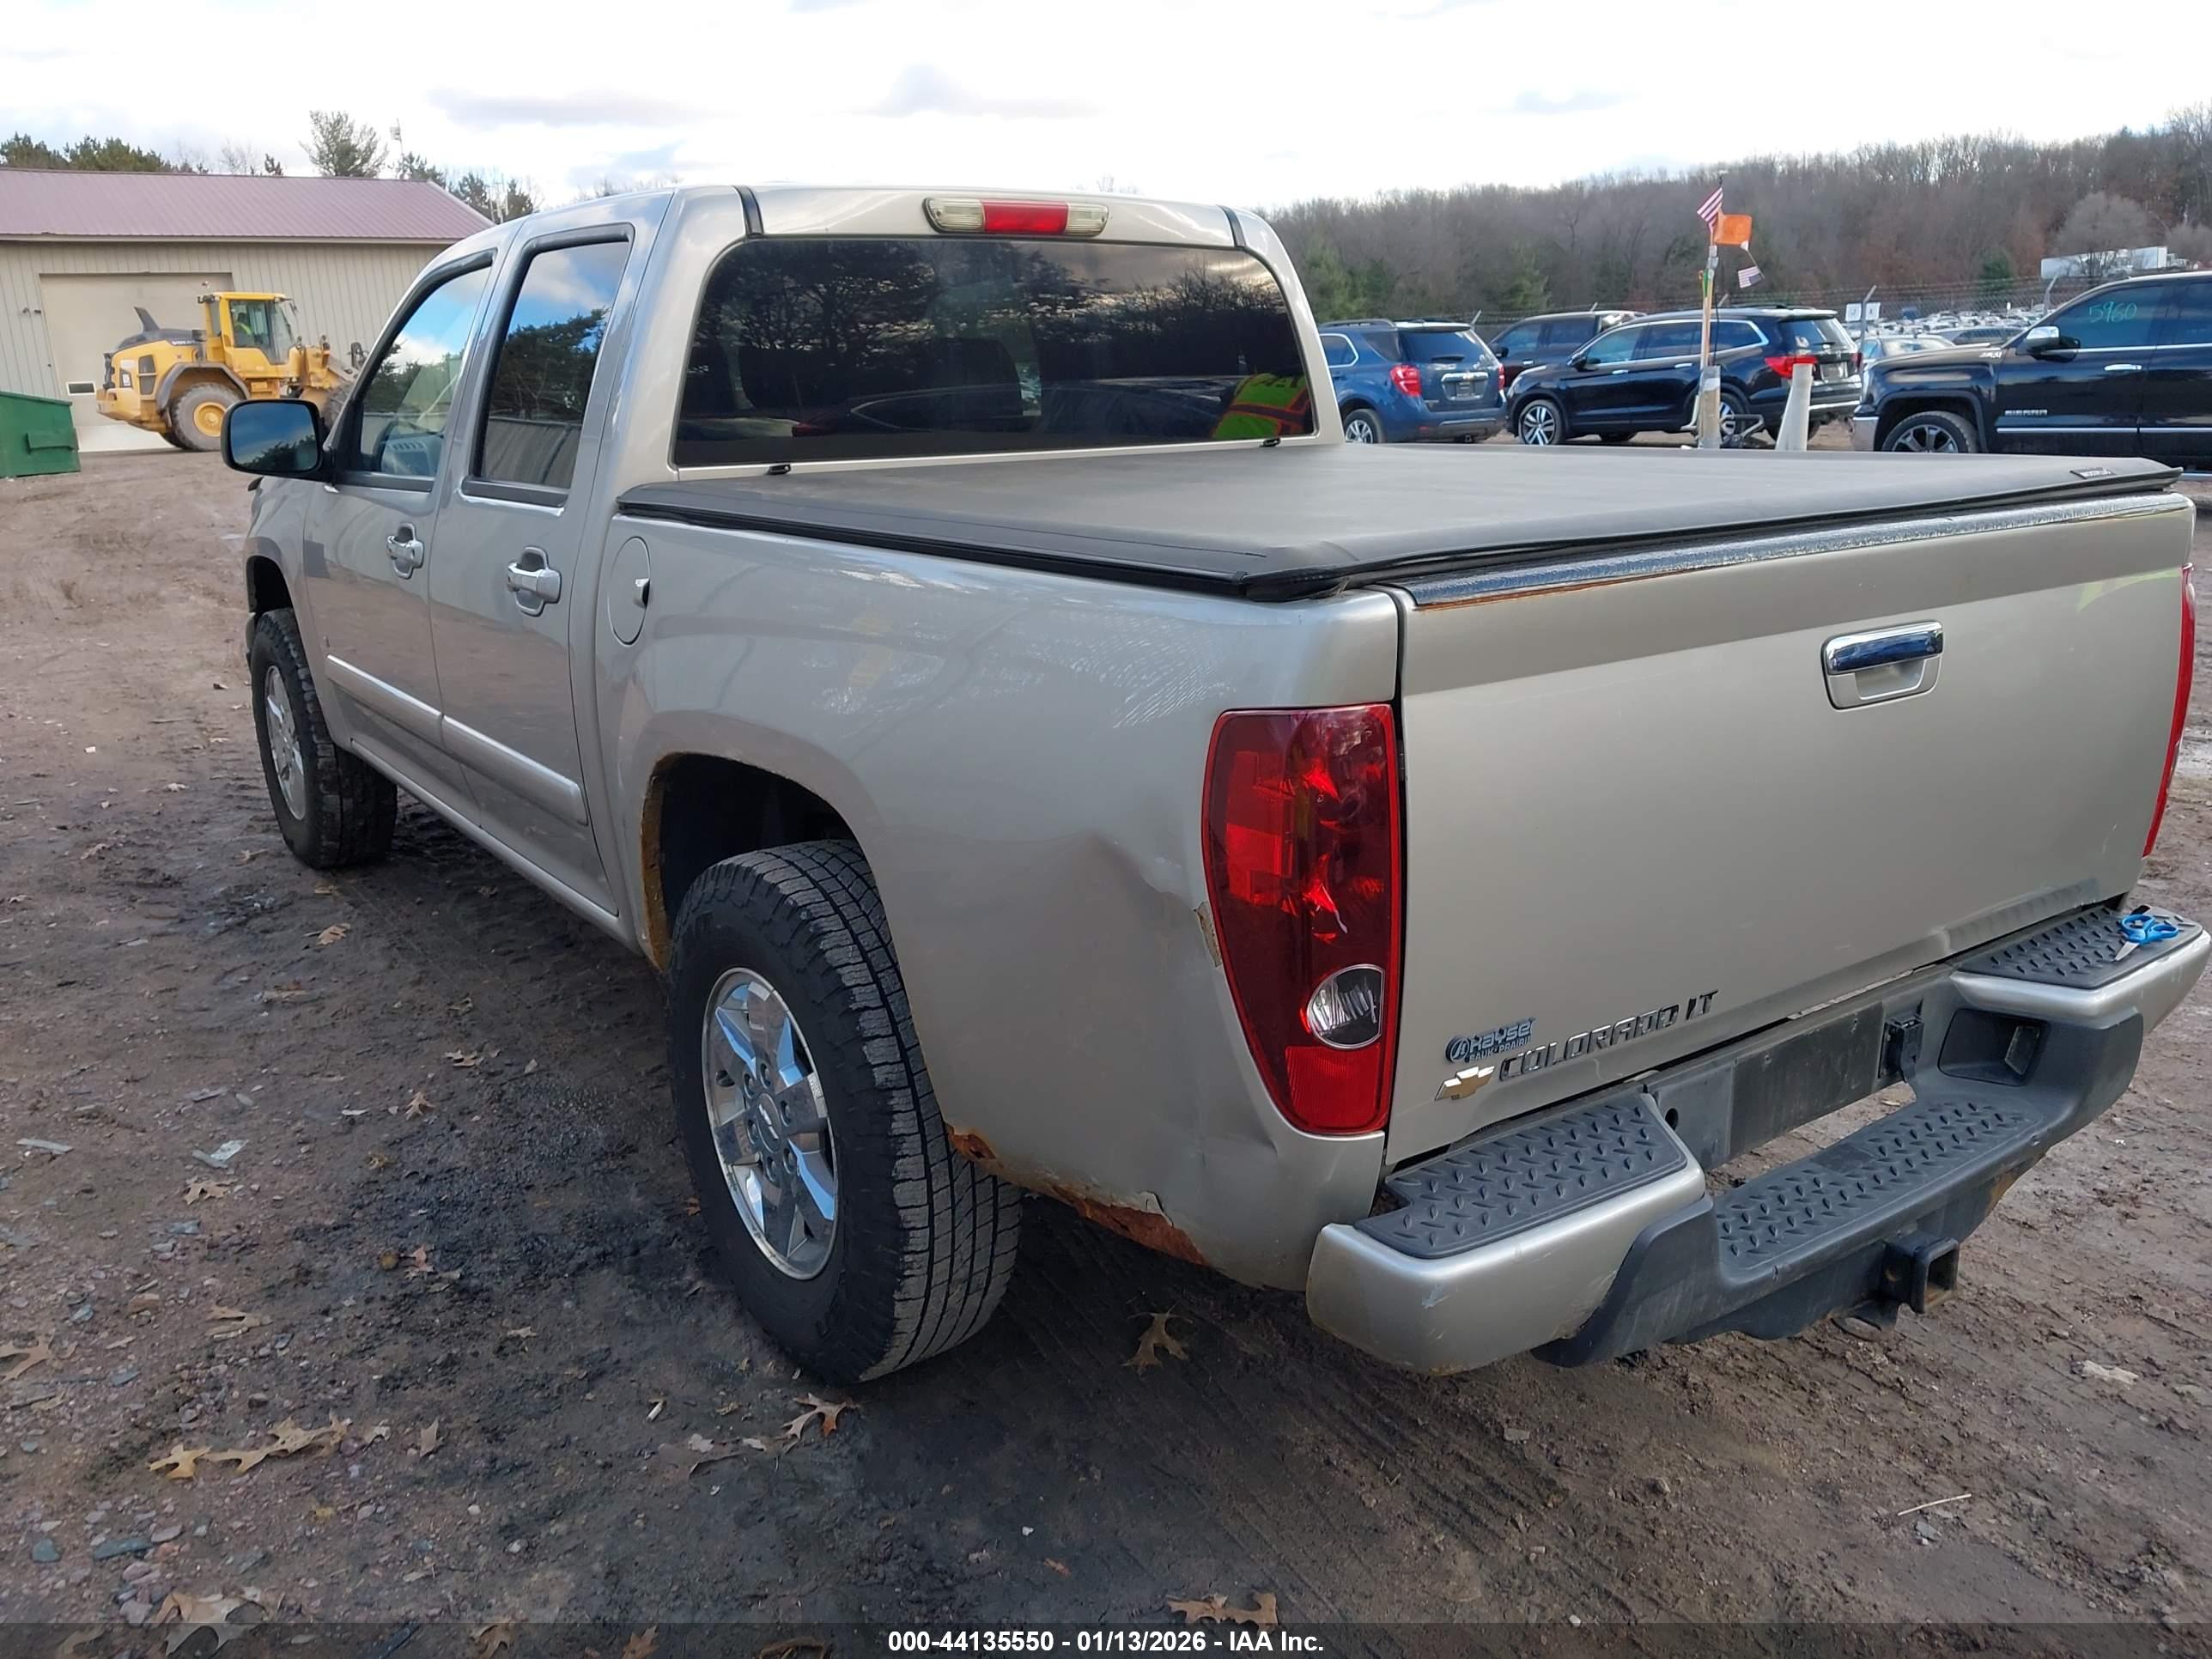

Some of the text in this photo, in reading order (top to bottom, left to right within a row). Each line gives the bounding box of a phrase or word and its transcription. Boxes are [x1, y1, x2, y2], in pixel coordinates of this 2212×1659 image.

[2089, 301, 2137, 323] 5960
[1500, 990, 1719, 1081] COLORADO LT
